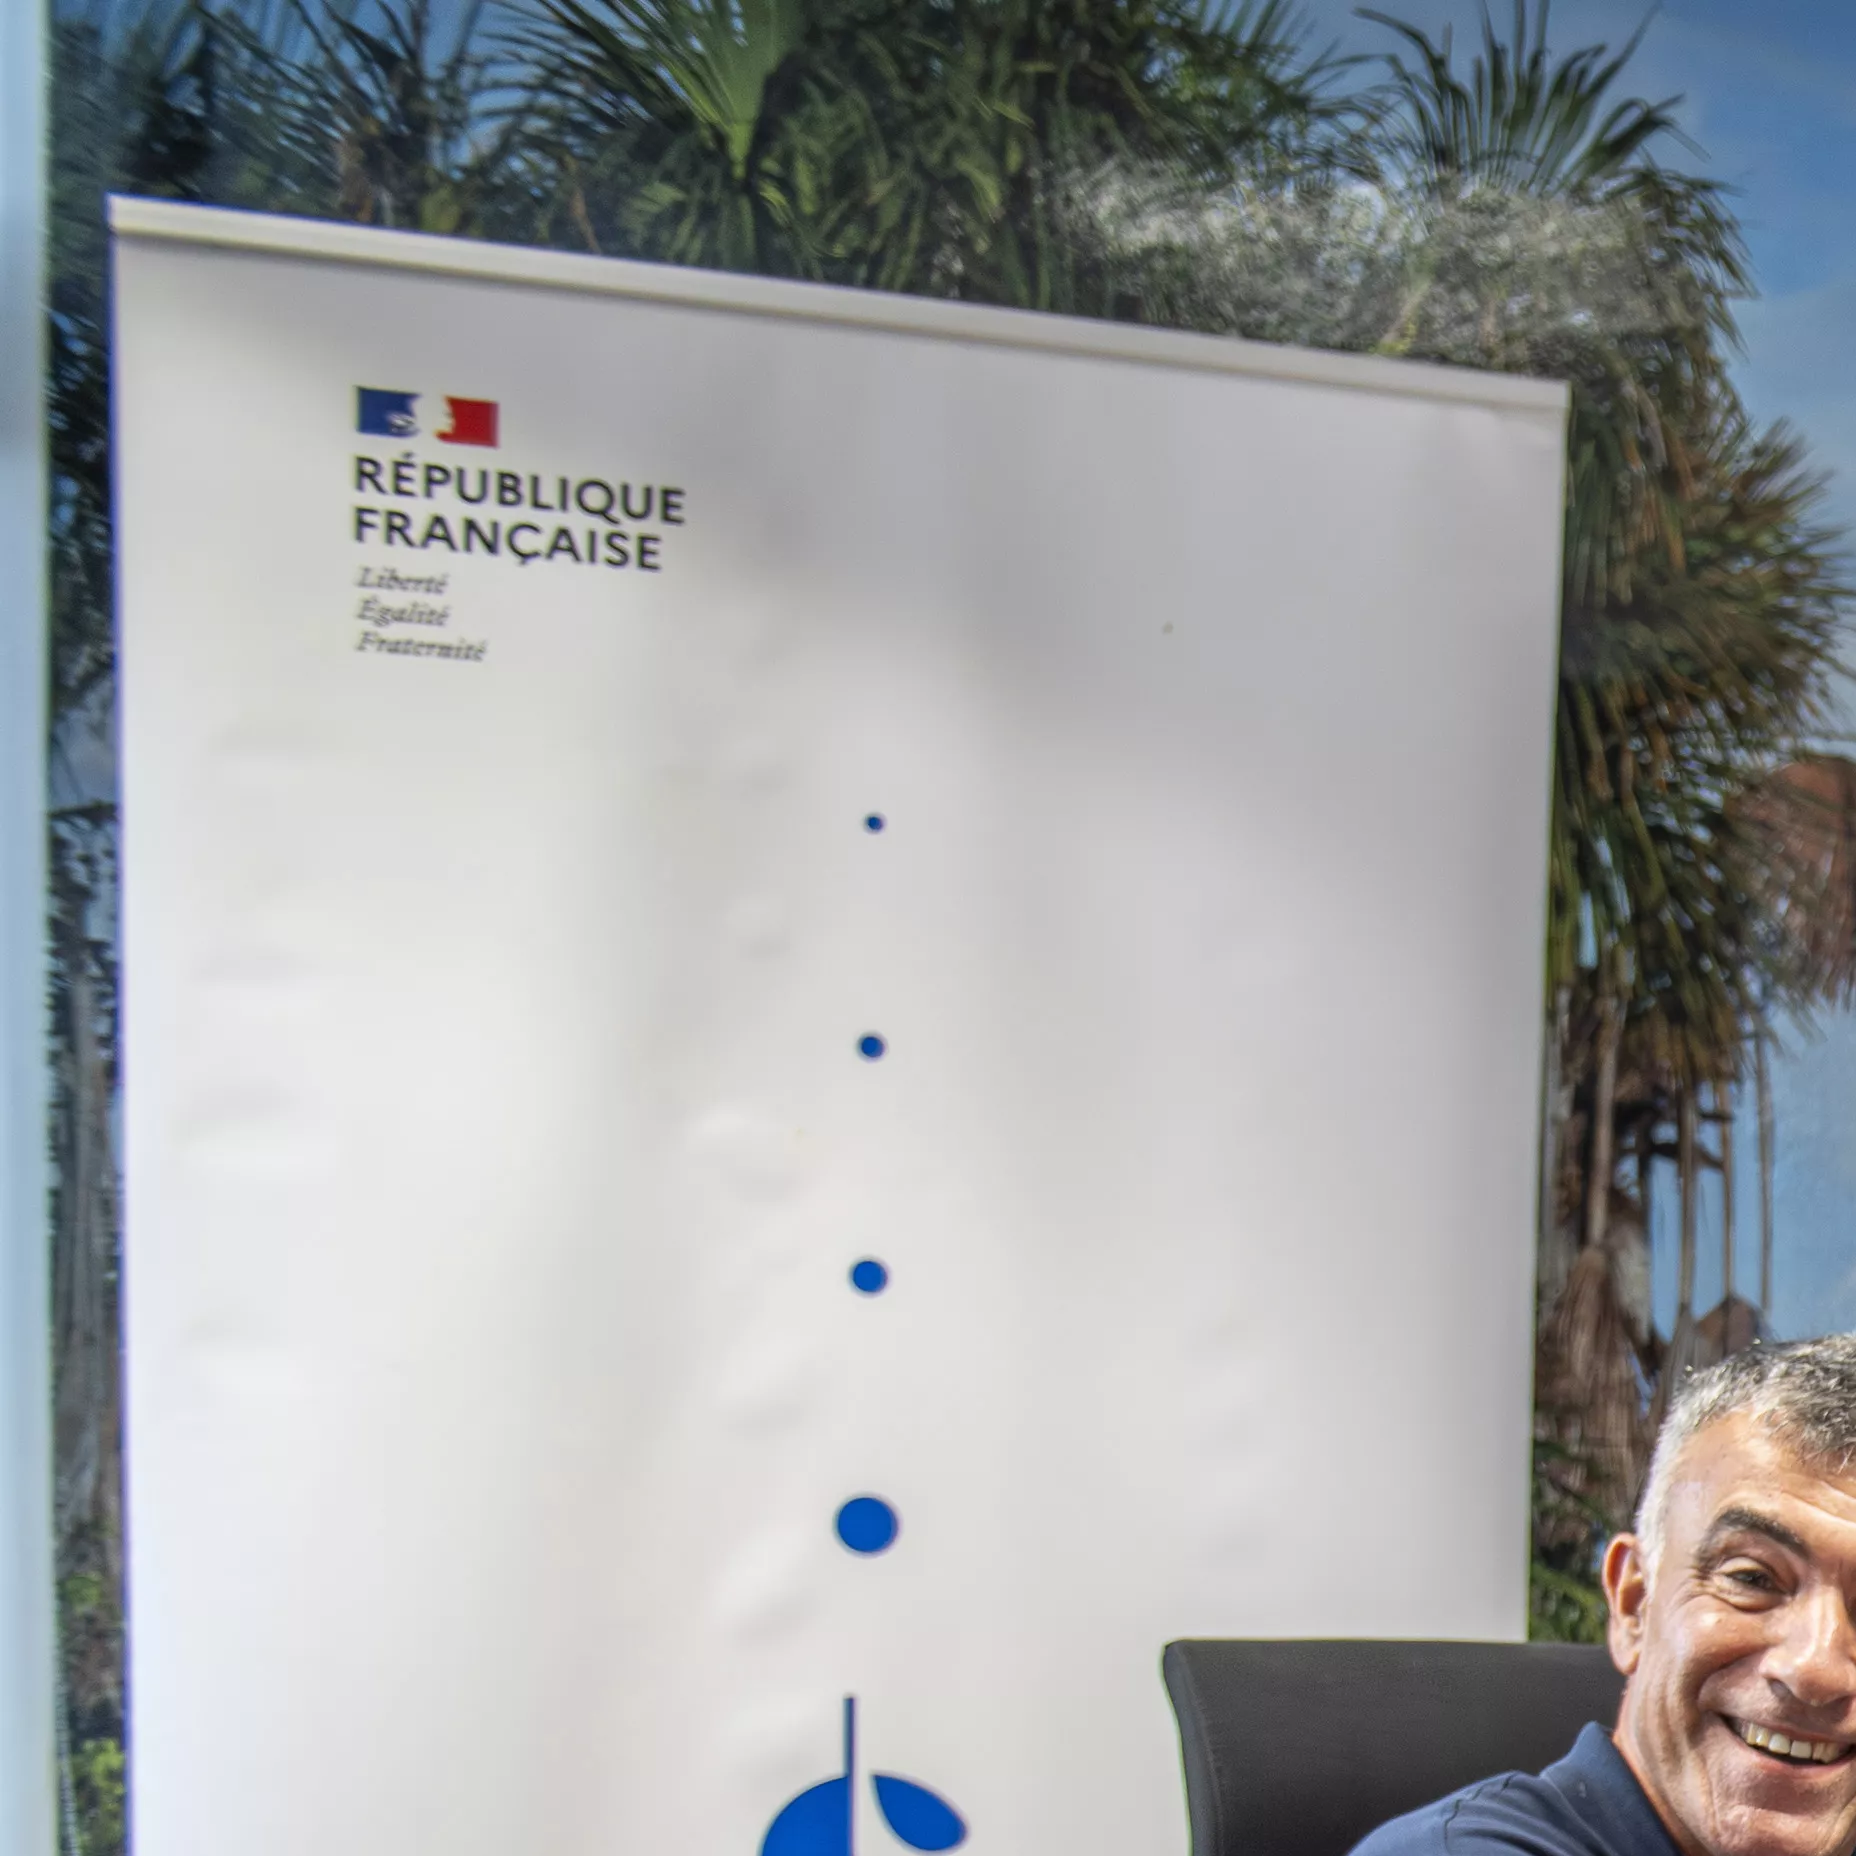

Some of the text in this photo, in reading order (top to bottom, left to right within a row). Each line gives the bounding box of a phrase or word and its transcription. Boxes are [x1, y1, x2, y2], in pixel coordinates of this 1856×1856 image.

[353, 450, 687, 526] RÉPUBLIQUE
[353, 505, 663, 573] FRANÇAISE
[355, 566, 449, 596] Liberté
[355, 597, 450, 628] Égalité
[355, 630, 488, 663] Fraternité
